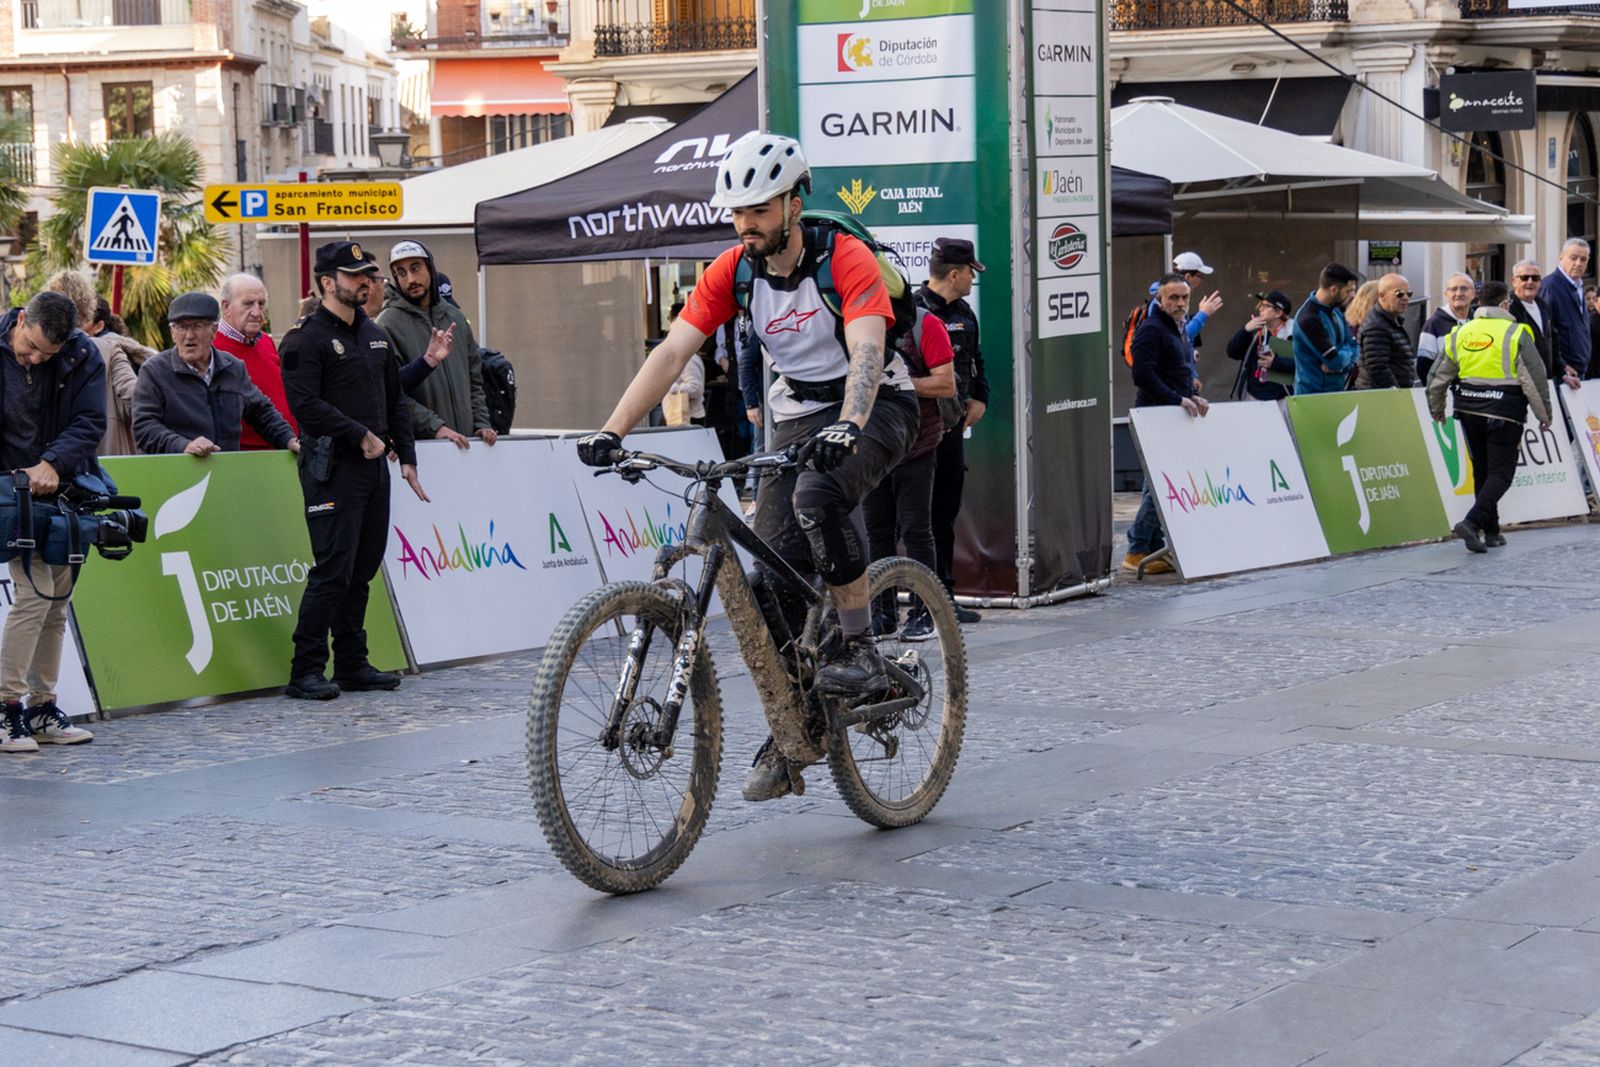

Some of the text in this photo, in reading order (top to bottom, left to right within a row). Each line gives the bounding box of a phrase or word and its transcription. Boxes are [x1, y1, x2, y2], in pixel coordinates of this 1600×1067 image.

[879, 37, 938, 54] Diputación
[1038, 44, 1091, 62] GARMIN
[879, 52, 938, 67] de Córdoba
[820, 107, 954, 137] GARMIN
[1053, 169, 1083, 195] Jaén
[275, 188, 397, 199] aparcamiento municipal
[881, 186, 943, 200] CAJA RURAL
[246, 192, 264, 215] P
[274, 201, 397, 216] San Francisco
[898, 200, 923, 214] JAÉN
[888, 256, 931, 267] TRITION
[1360, 461, 1409, 481] DIPUTACIÓN
[1161, 464, 1255, 514] Andalucía
[1365, 483, 1400, 502] DE JAÉN
[393, 519, 527, 581] Andalucía
[542, 555, 588, 569] Junta de Andalucía
[211, 593, 292, 623] DE JAÉN
